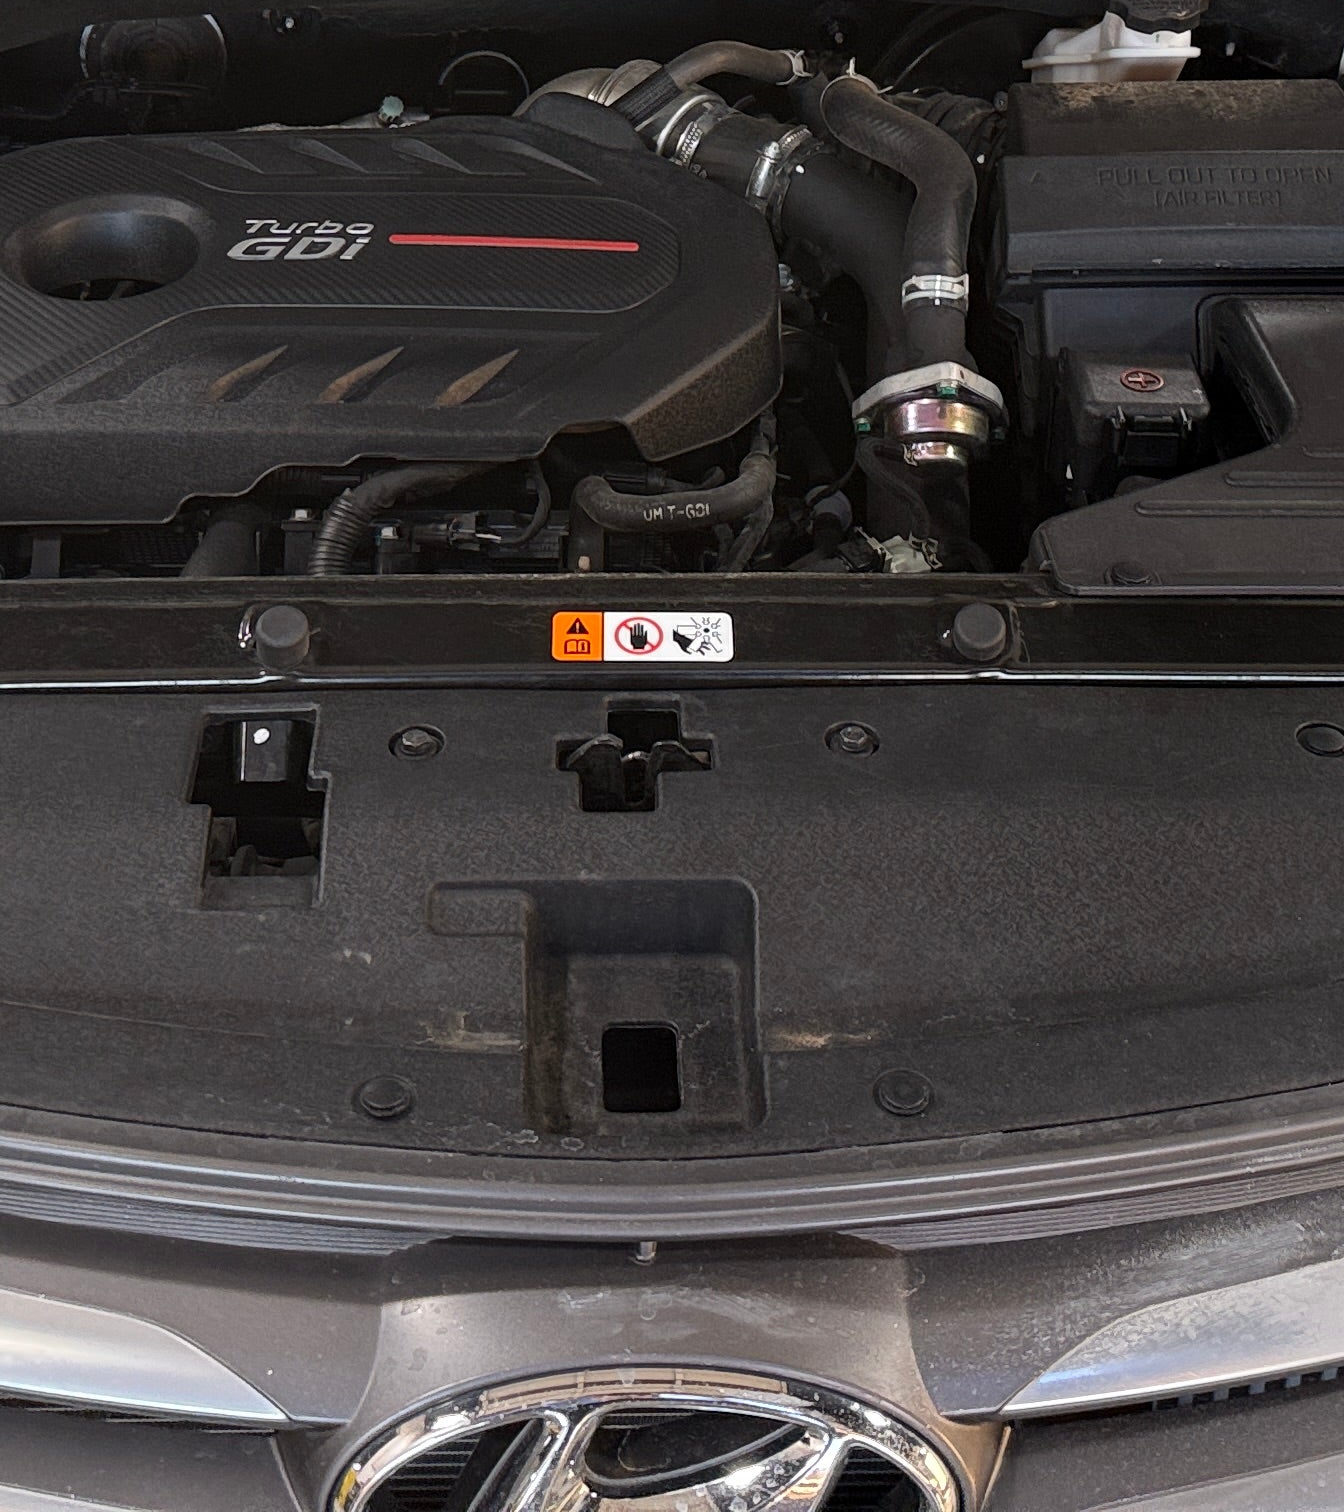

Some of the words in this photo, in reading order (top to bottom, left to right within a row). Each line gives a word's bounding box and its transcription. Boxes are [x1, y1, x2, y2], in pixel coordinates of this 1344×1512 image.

[1097, 166, 1162, 186] PULL
[1166, 166, 1218, 185] OUT
[1226, 166, 1258, 185] TO
[1264, 166, 1333, 185] OPEN
[245, 219, 375, 235] Turbo
[226, 236, 372, 261] GDi
[643, 507, 663, 522] UM
[667, 503, 711, 521] T-GDI
